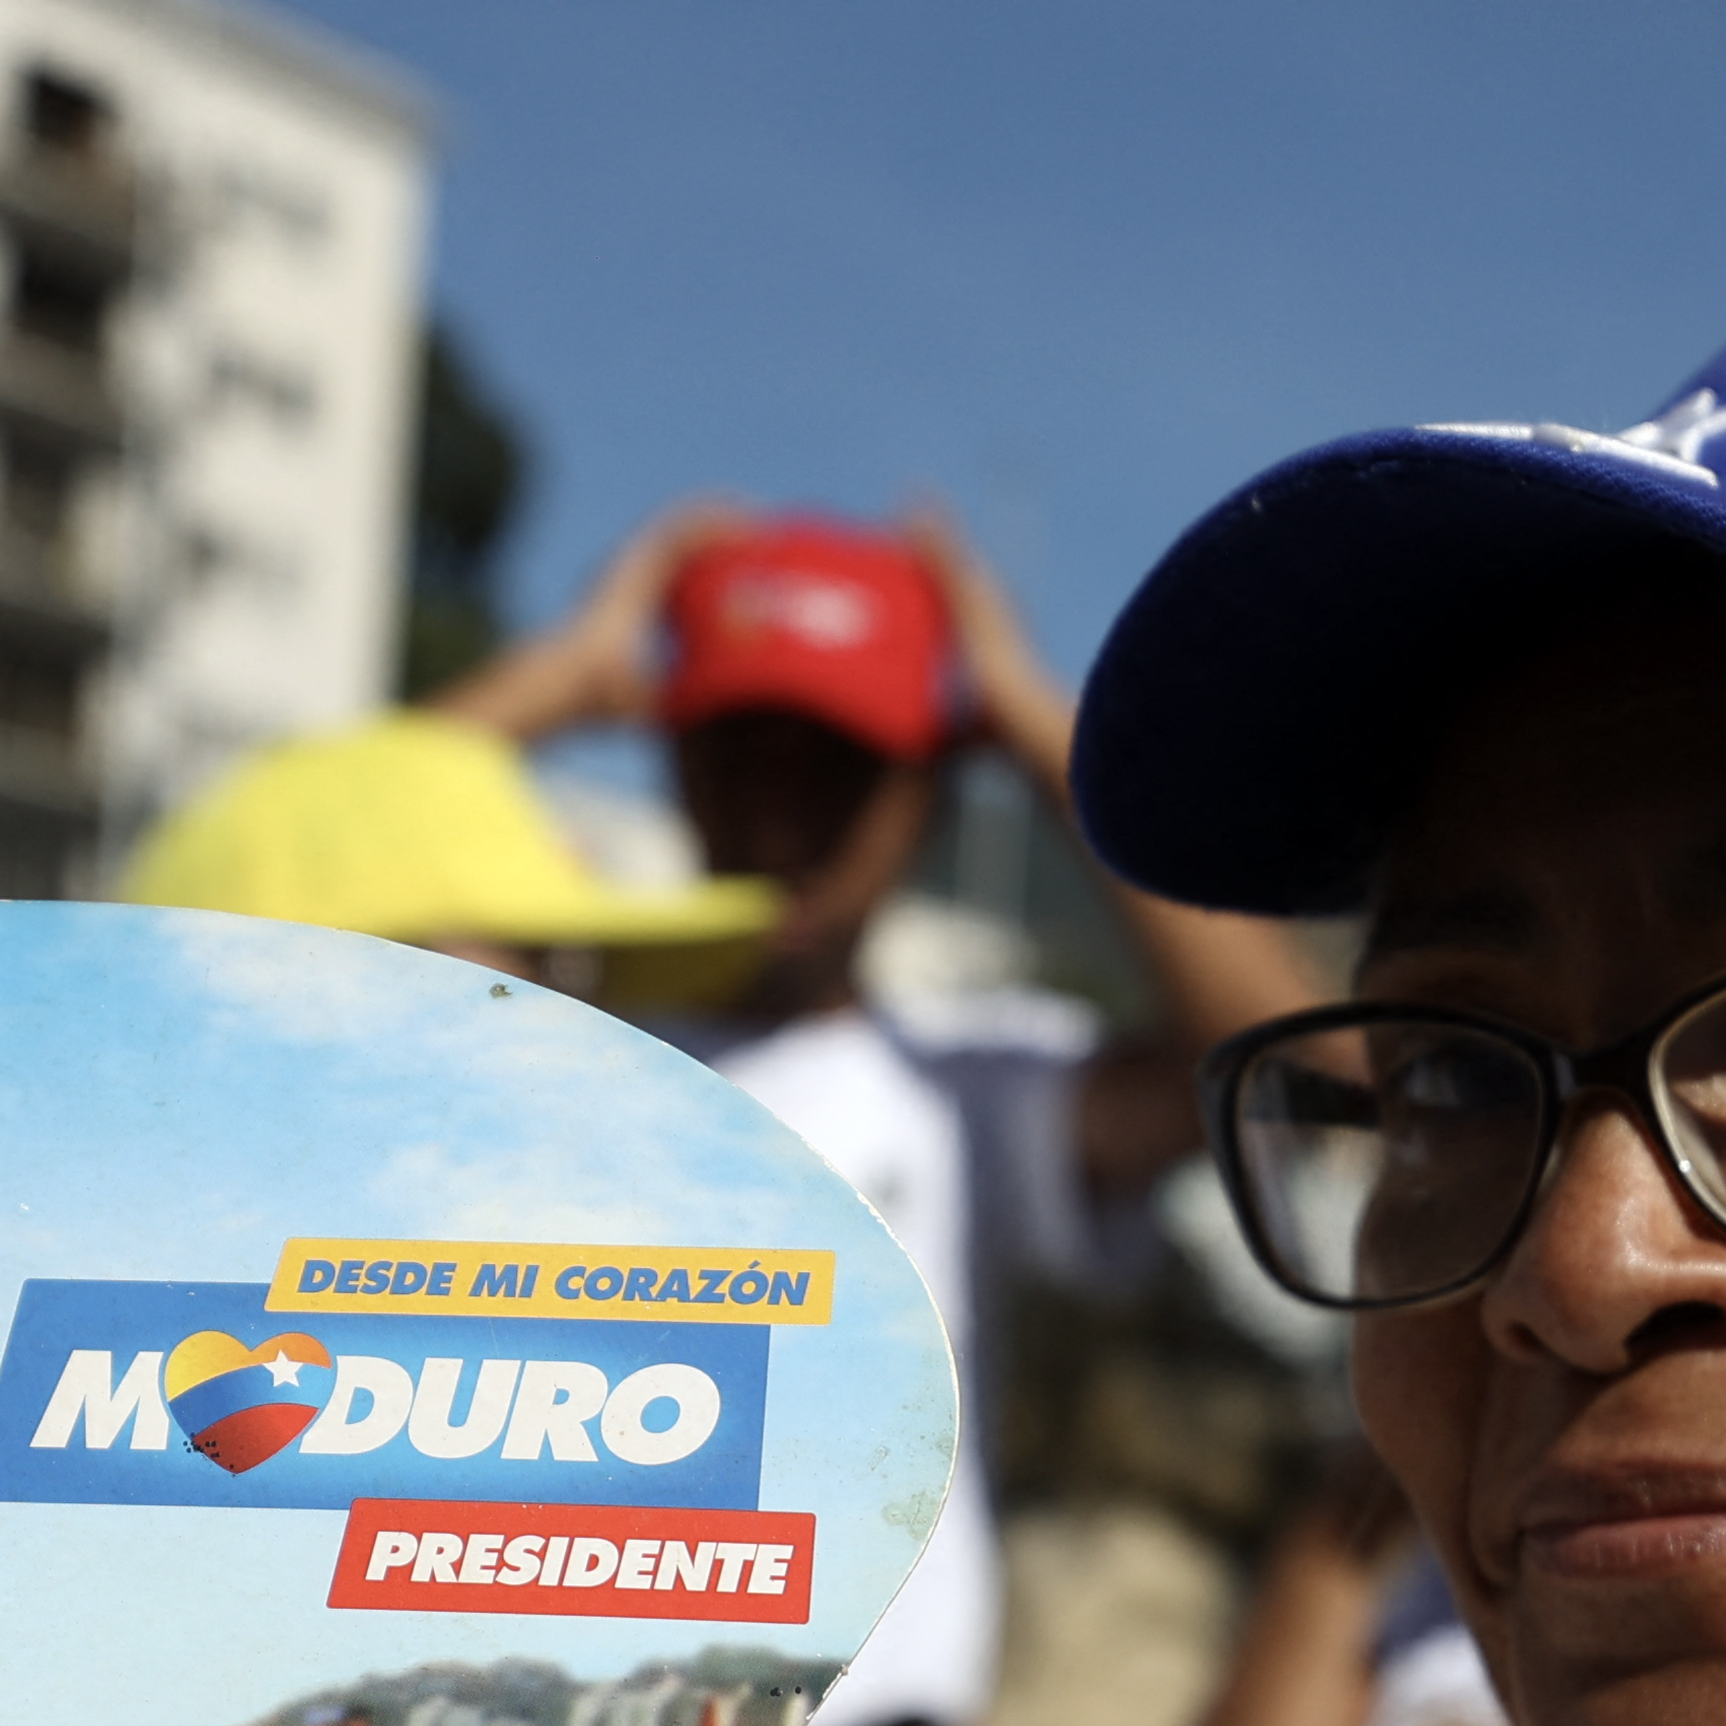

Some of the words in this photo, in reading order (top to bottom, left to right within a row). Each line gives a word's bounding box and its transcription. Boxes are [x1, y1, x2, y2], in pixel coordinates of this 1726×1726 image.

[296, 1259, 458, 1297] DESDE
[468, 1263, 540, 1299] MI
[554, 1260, 812, 1307] CORAZÓN
[28, 1330, 722, 1476] MDURO
[364, 1530, 796, 1596] PRESIDENTE
